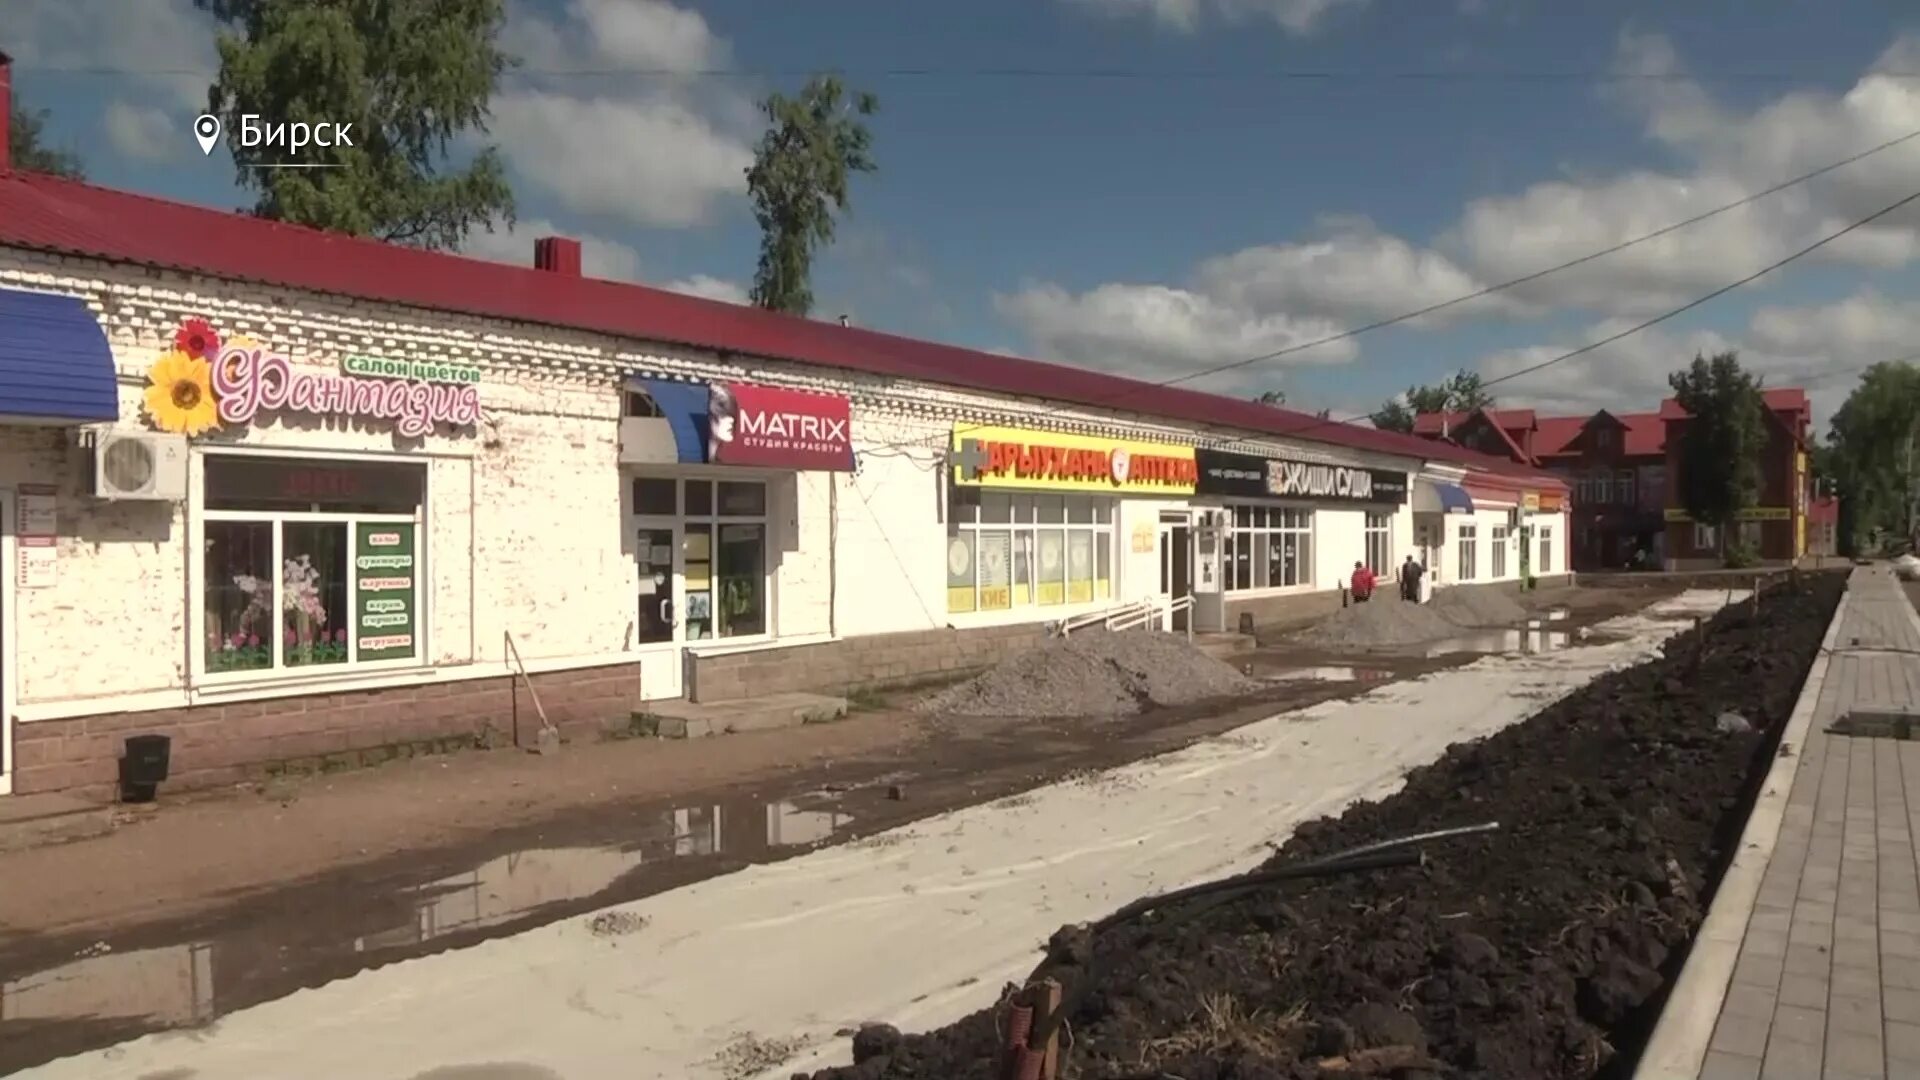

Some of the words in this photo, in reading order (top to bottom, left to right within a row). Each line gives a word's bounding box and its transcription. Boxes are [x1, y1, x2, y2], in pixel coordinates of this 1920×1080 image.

[347, 357, 408, 376] салон
[413, 366, 481, 383] цветов
[213, 347, 484, 435] Фантазия
[740, 408, 847, 443] MATRIX
[743, 436, 790, 449] СТУДИЯ
[792, 440, 843, 453] КРАСОТЫ
[1128, 454, 1198, 483] АПТЕКА
